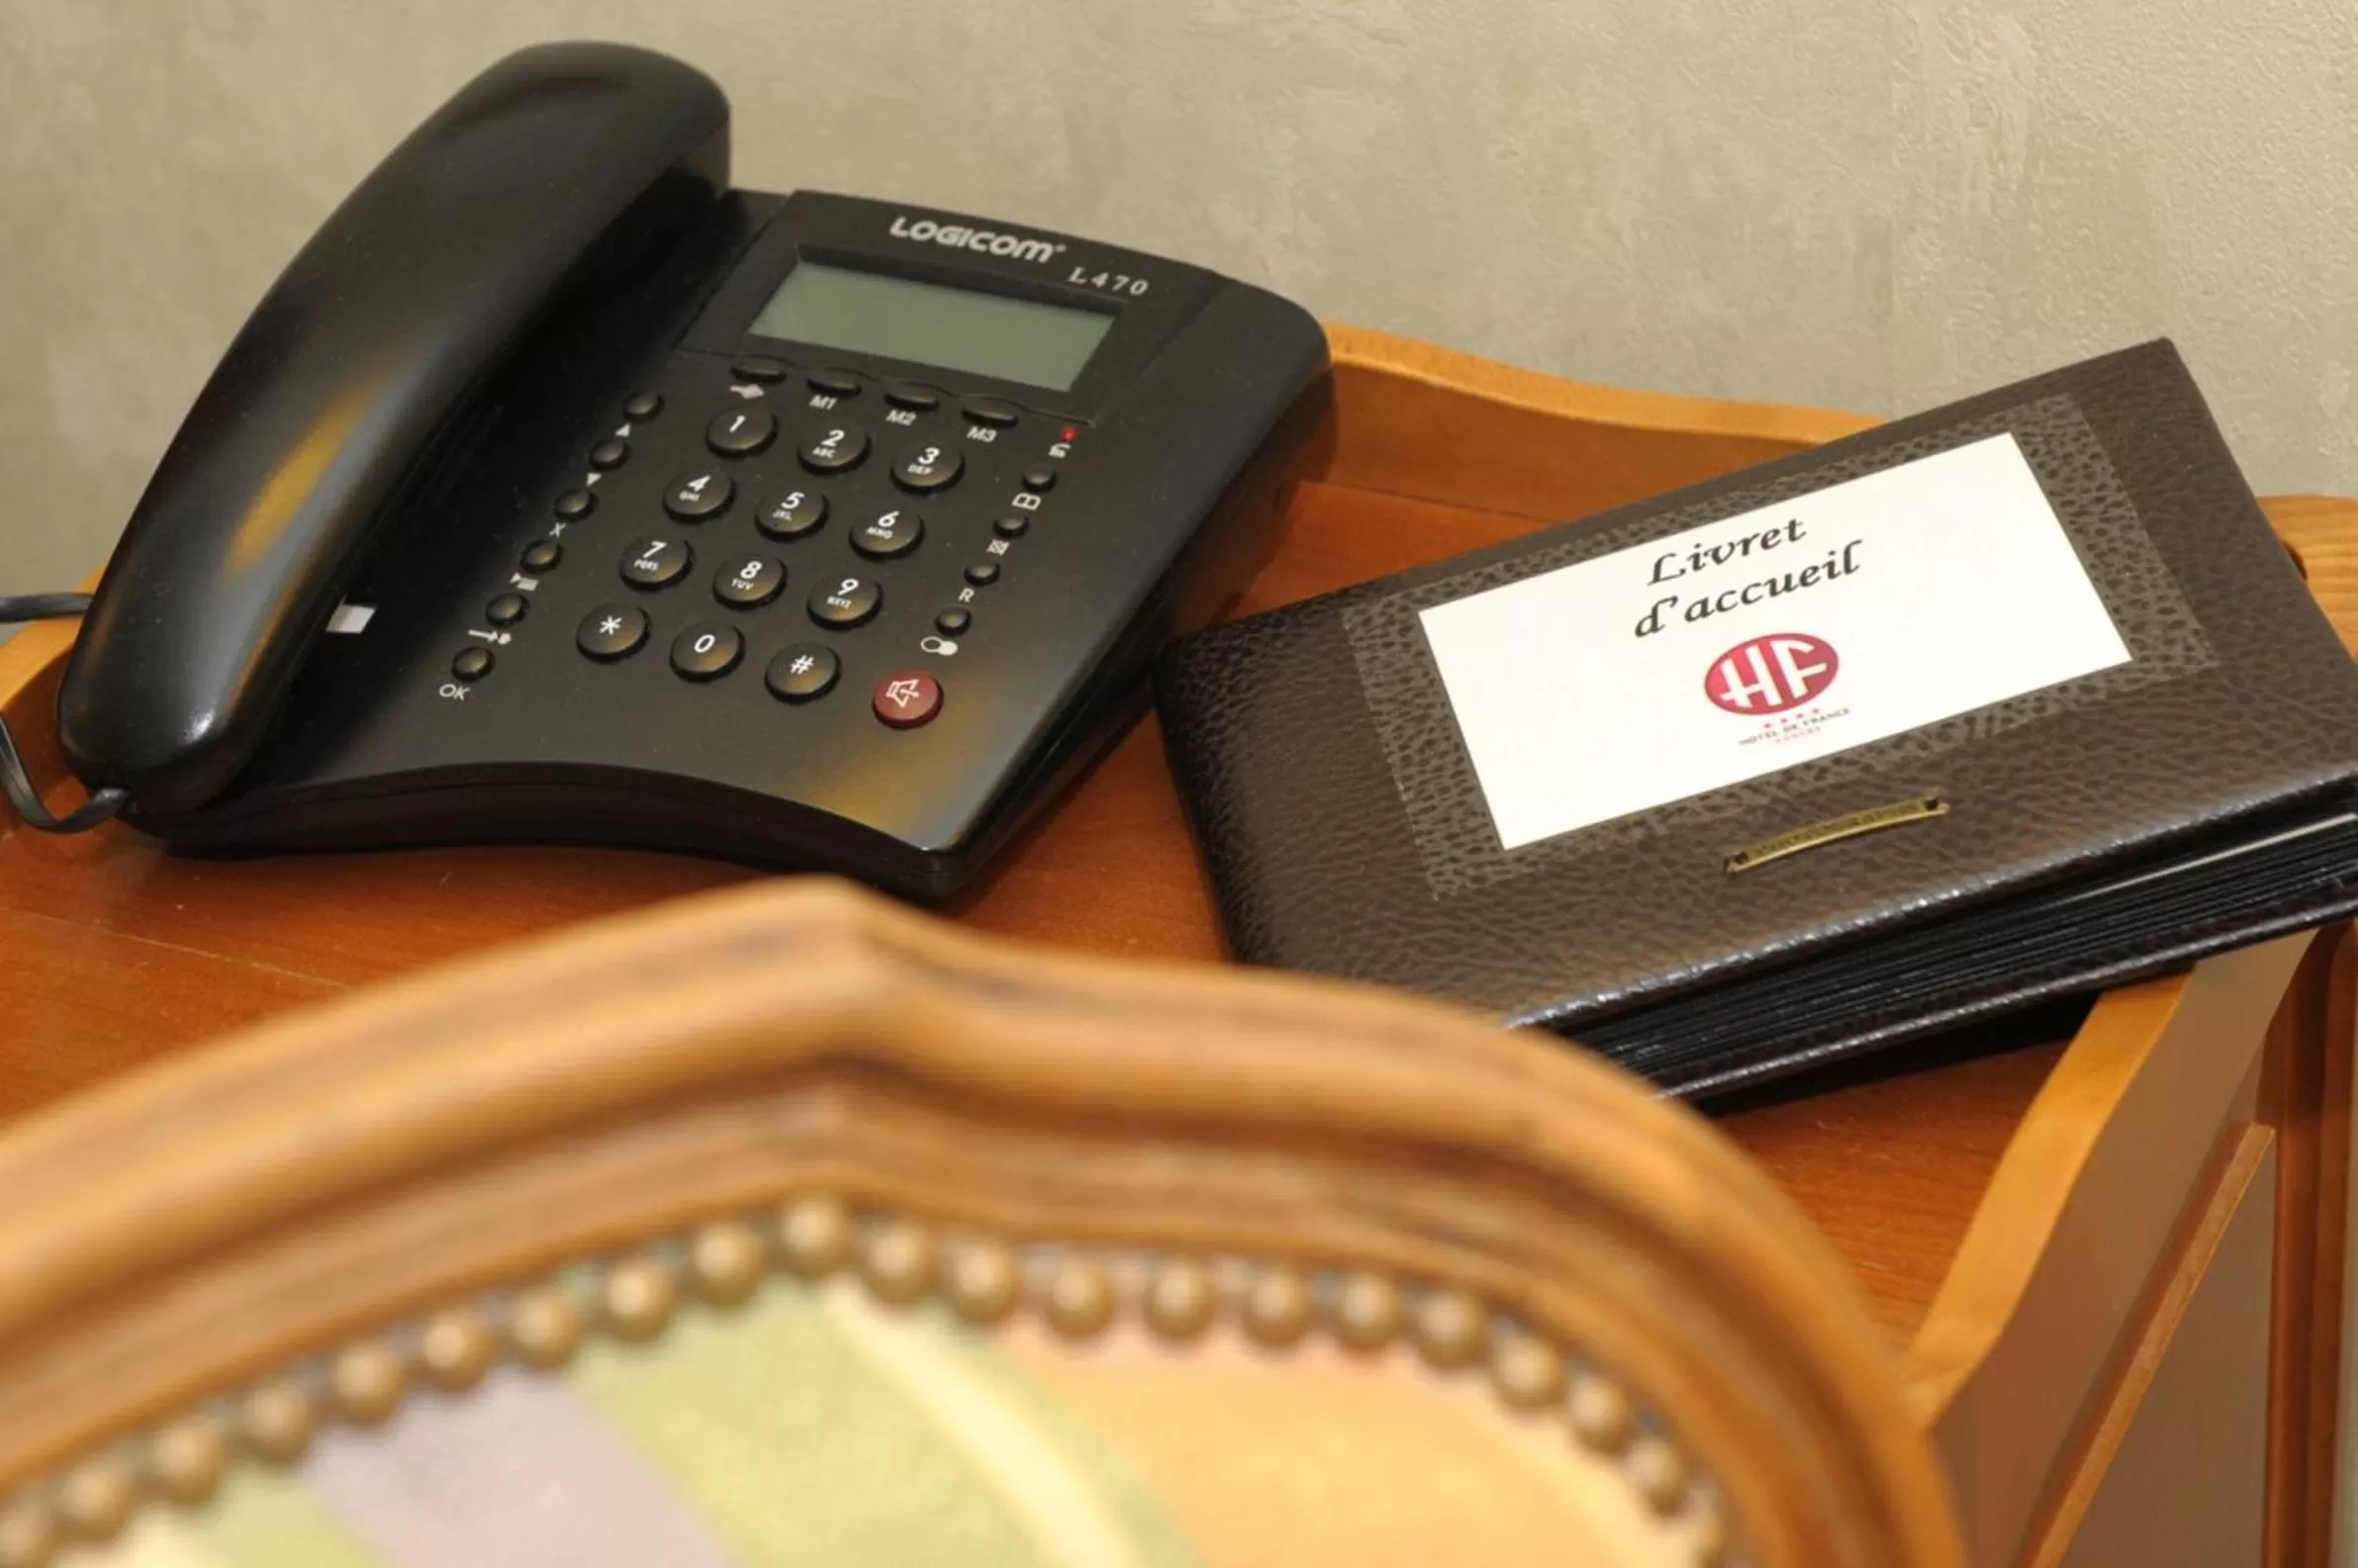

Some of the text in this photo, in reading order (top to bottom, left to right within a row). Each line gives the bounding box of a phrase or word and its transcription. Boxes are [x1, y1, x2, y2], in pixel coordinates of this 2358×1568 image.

[890, 216, 1056, 263] LOGICOM
[1068, 266, 1149, 295] L470
[808, 394, 837, 411] M1
[728, 414, 746, 433] 1
[886, 410, 917, 426] M2
[821, 428, 845, 447] 2
[967, 425, 998, 443] M3
[811, 446, 837, 459] ABC
[917, 447, 941, 465] 3
[907, 464, 934, 476] DEF
[687, 475, 711, 492] 4
[781, 492, 805, 509] 5
[878, 510, 900, 527] 6
[866, 526, 894, 539] MNO
[642, 540, 667, 558] 7
[1647, 518, 1807, 586] Livret
[740, 561, 763, 579] 8
[731, 578, 755, 591] TUV
[837, 578, 859, 596] 9
[1635, 538, 1863, 638] d'accueil
[958, 588, 975, 602] R
[693, 633, 716, 654] 0
[790, 654, 814, 676] #
[439, 683, 471, 700] OK
